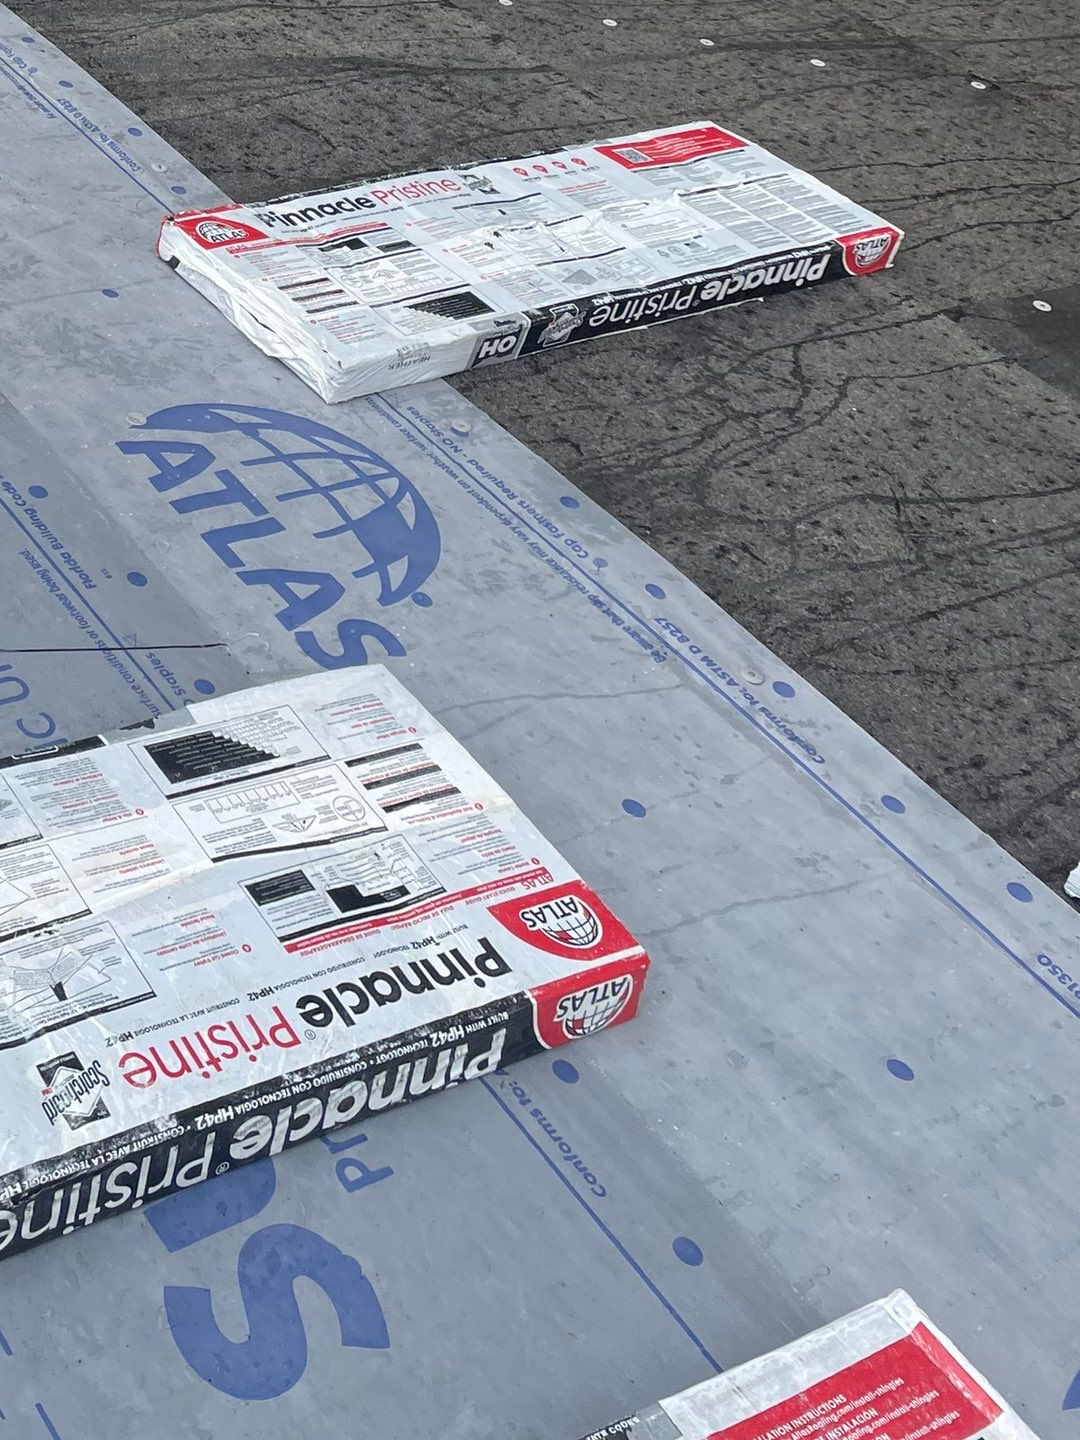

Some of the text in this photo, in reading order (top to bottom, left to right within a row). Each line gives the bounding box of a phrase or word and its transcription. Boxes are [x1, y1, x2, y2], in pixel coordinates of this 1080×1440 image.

[254, 194, 376, 227] Pinnacle
[370, 178, 461, 207] Pristine
[211, 230, 249, 243] ATLAS
[856, 233, 891, 255] ATLAS
[701, 253, 831, 302] Pinnacle
[589, 285, 694, 327] Pristine
[478, 335, 517, 358] OH
[1, 481, 27, 507] Code
[407, 406, 589, 559] Cap Fastners Required NO Staples
[24, 508, 64, 551] Building
[467, 488, 590, 595] resistance dependent
[60, 551, 97, 590] Florida
[116, 440, 407, 669] ATLAS
[36, 565, 91, 630] footwear being
[145, 652, 186, 697] Staples
[654, 617, 826, 764] Conforms ASTM 8257
[522, 872, 555, 891] ATLAS
[519, 895, 578, 928] ATLAS
[247, 935, 438, 1002] HP42 HP42
[119, 937, 513, 1089] Pinnacle Pristine
[556, 975, 631, 1021] ATLAS
[430, 1026, 466, 1048] HP42
[467, 1021, 488, 1035] WITH
[488, 1011, 509, 1026] BUILT
[376, 1040, 428, 1065] TECHNOLOGY
[292, 1079, 312, 1094] CON
[313, 1060, 367, 1087] CONSTRUIDO
[42, 1060, 110, 1126] Scotchgard
[230, 1028, 506, 1161] Pinnacle
[194, 1105, 234, 1131] HP42
[105, 1144, 131, 1162] AVEC
[132, 1126, 185, 1153] CONSTRUIT
[529, 1105, 608, 1200] Conforms
[23, 1160, 89, 1190] TECHNOLOGIE
[790, 1393, 848, 1431] INSTRUCTIONS
